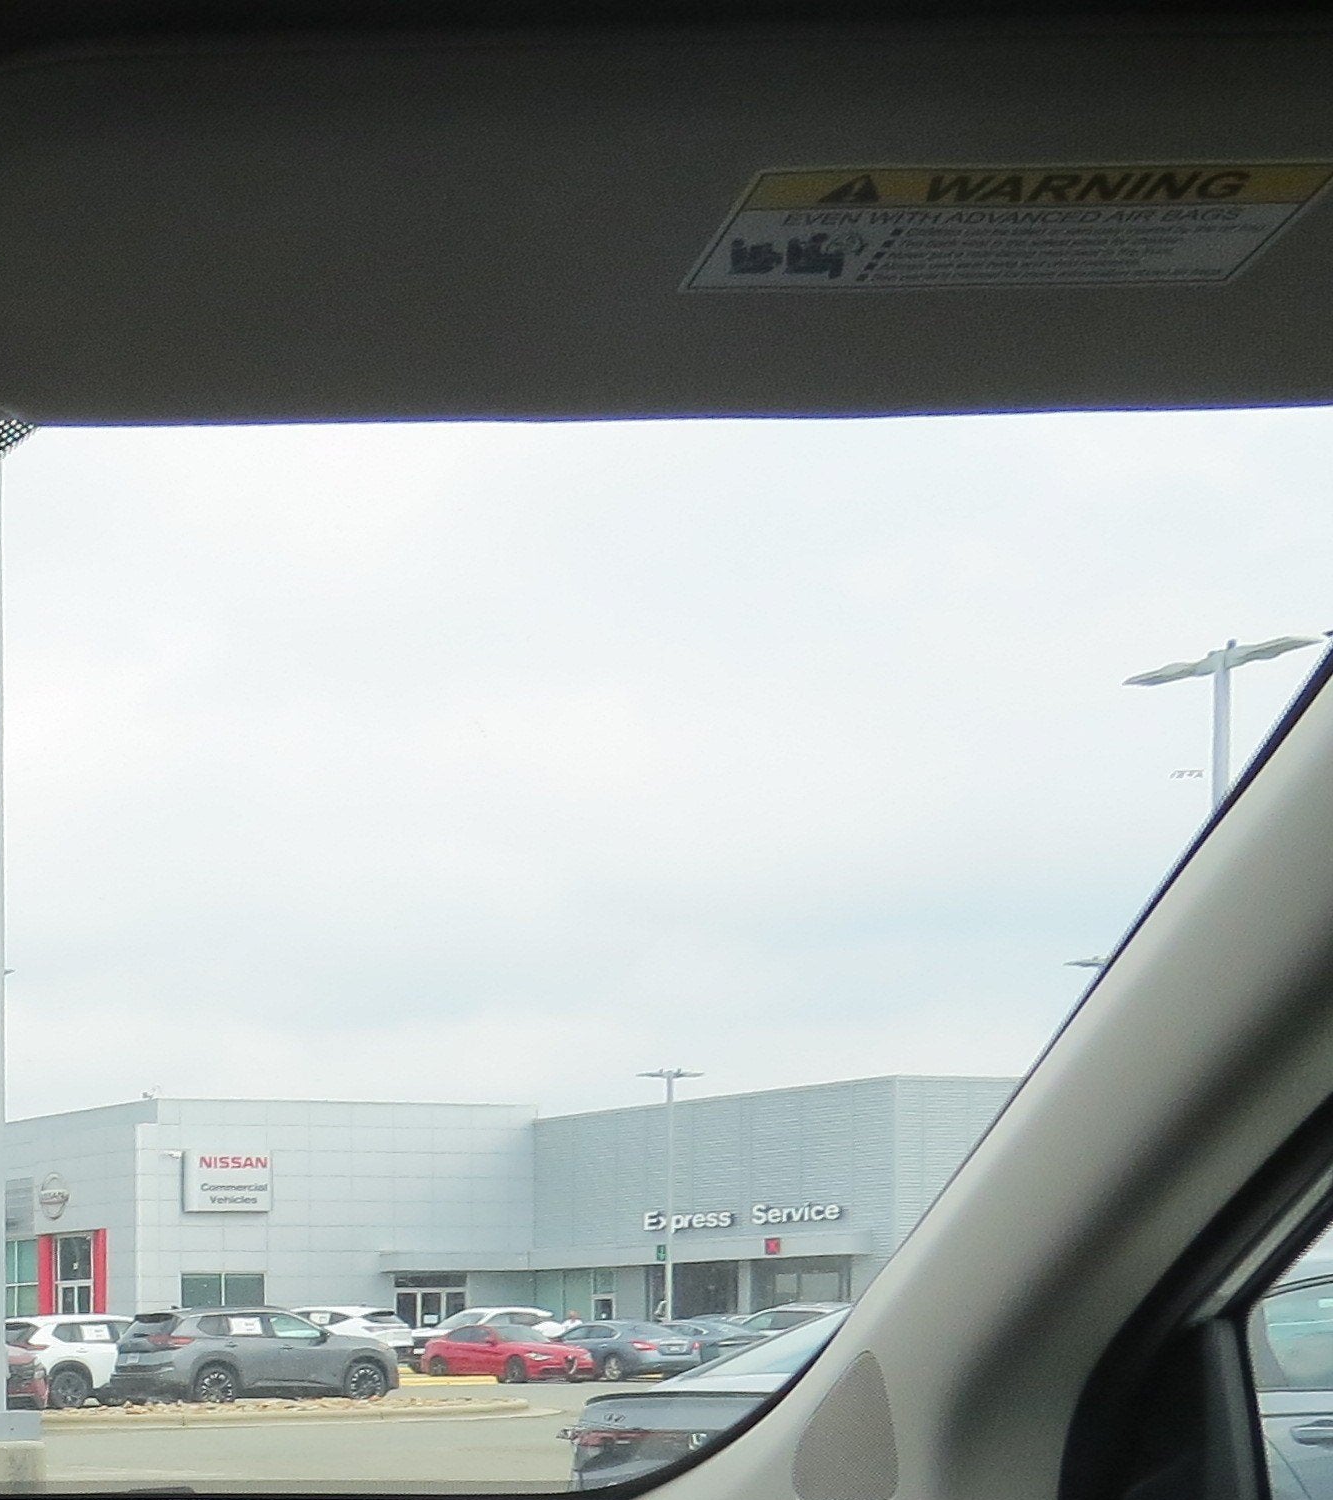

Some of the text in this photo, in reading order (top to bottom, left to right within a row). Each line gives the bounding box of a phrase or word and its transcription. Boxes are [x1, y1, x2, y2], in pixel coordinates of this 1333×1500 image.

[926, 171, 1251, 203] WARNING
[783, 207, 1242, 226] EVEN WITH ADVANCED AIR BAGS
[199, 1156, 268, 1169] NISSAN
[201, 1182, 268, 1192] Commercial
[210, 1195, 258, 1204] Vehicles
[643, 1201, 841, 1235] Express Service
